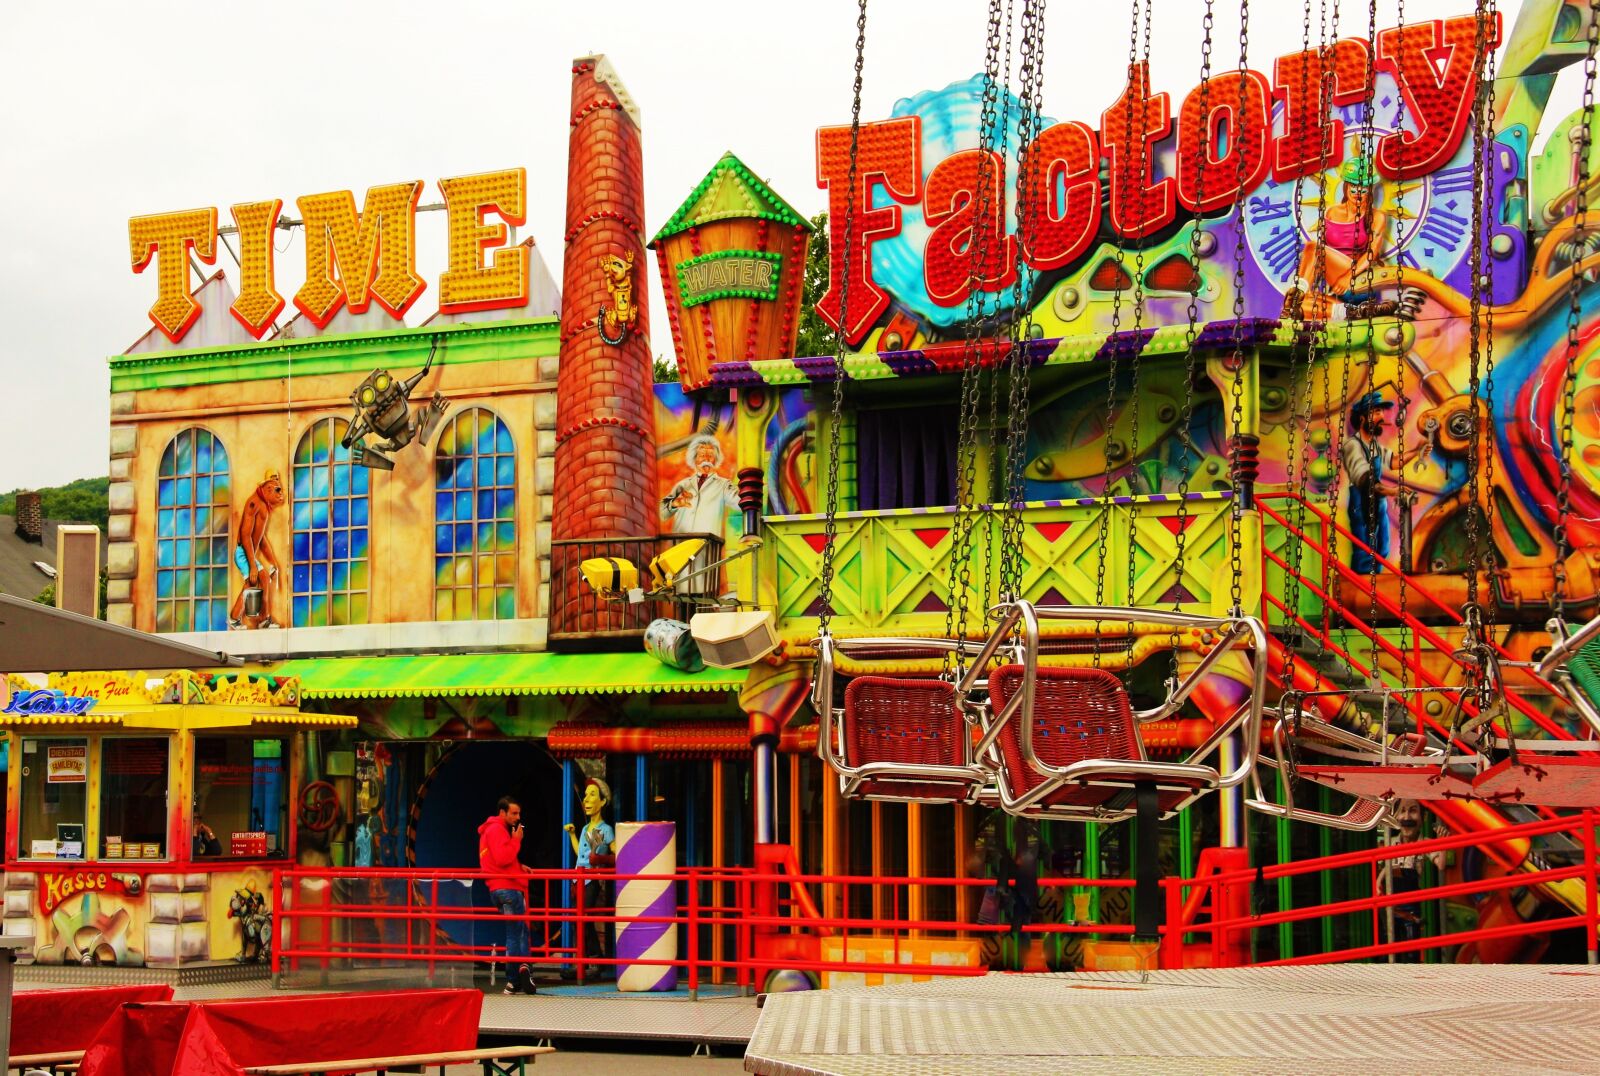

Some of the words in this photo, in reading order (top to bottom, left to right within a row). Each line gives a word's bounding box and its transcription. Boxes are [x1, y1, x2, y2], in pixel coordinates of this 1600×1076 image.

[816, 12, 1502, 348] Factory
[129, 167, 529, 344] TIME
[684, 258, 773, 293] WATER
[1, 688, 91, 715] Kasse
[104, 681, 131, 699] Fun
[50, 749, 84, 757] DIENSTAG
[44, 873, 107, 910] Kasse
